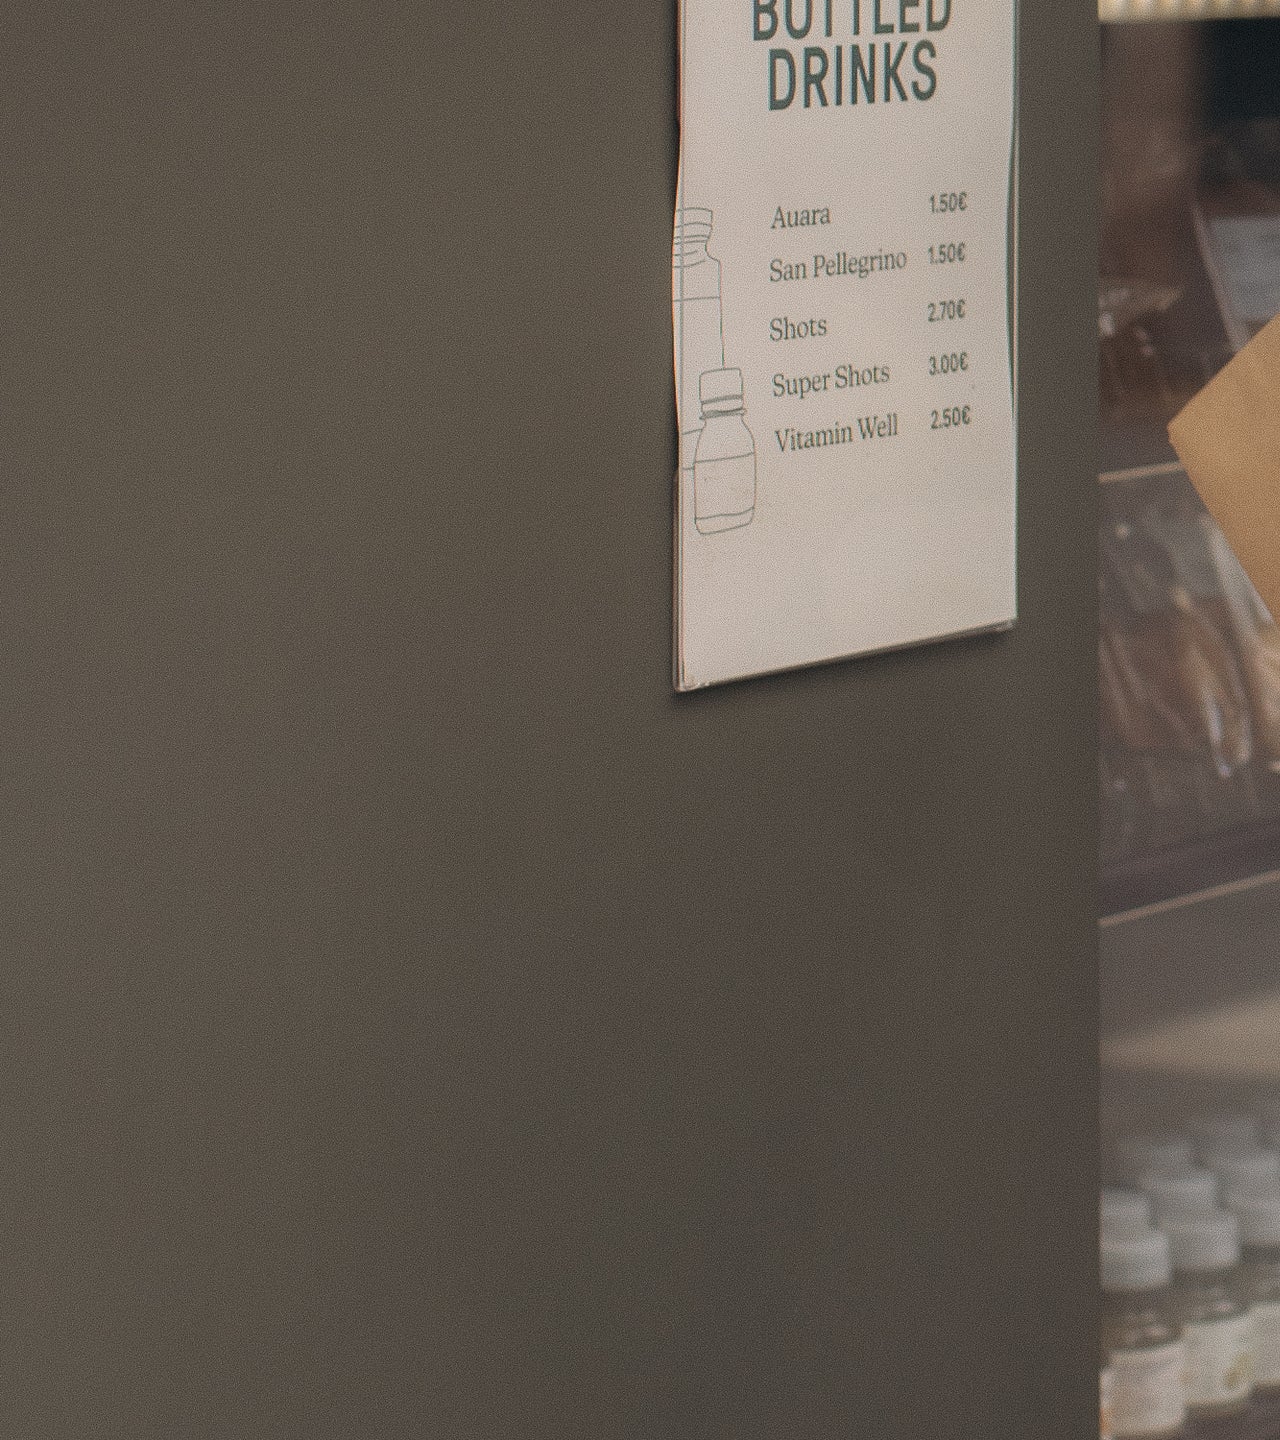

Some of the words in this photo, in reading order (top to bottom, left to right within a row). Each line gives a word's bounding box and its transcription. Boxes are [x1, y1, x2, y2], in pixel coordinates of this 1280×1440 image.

[767, 39, 938, 111] DRINKS
[770, 205, 832, 229] Auara
[929, 191, 968, 214] 1.50€
[769, 258, 807, 282] San
[812, 247, 908, 279] Pellegrino
[927, 241, 966, 265] 1.50€
[769, 317, 828, 342] Shots
[927, 299, 966, 323] 2.70€
[771, 373, 830, 400] Super
[834, 363, 890, 389] Shots
[929, 351, 969, 376] 3.00€
[774, 421, 854, 452] Vitamin
[856, 412, 898, 440] Well
[930, 405, 971, 430] 2.50€
